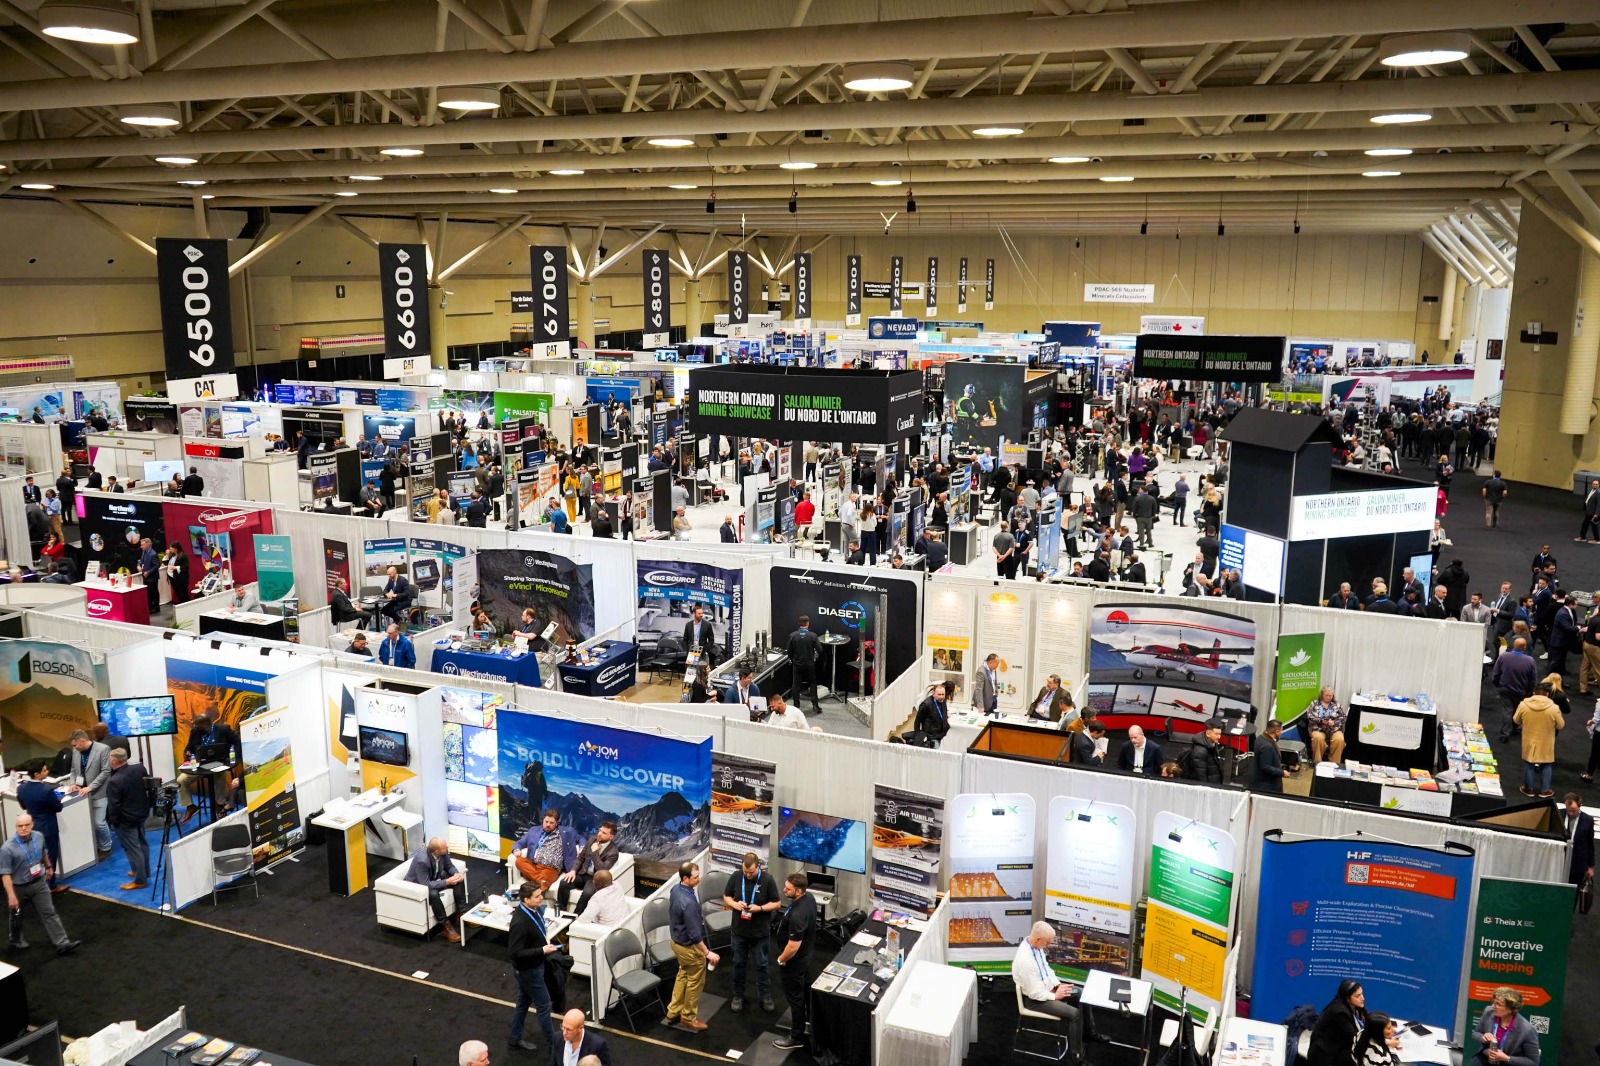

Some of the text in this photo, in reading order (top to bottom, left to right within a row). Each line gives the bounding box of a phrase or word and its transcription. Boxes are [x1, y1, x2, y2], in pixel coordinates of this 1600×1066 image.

[651, 266, 662, 328] 6800
[734, 266, 742, 320] 6900
[798, 267, 806, 314] 7000
[542, 266, 558, 336] 6700
[395, 266, 416, 350] 6600
[183, 266, 216, 367] 6500
[546, 346, 557, 356] CAT
[1144, 349, 1199, 360] NORTHERN ONTARIO
[1206, 352, 1247, 361] SALON MINIER
[404, 360, 414, 370] CAT
[1143, 359, 1196, 368] MINING SHOWCASE
[1205, 361, 1272, 371] DU NORD DE L'ONTARIO
[194, 380, 214, 398] CAT
[698, 389, 774, 407] NORTHERN ONTARIO
[784, 395, 842, 410] SALON MINIER
[698, 403, 772, 420] MINING SHOWCASE
[784, 408, 876, 425] DU NORD DE L'ONTARIO
[1305, 496, 1360, 509] NORTHERN ONTARIO
[1366, 493, 1405, 505] SALON MINIER
[1305, 507, 1357, 520] MINING SHOWCASE
[1366, 506, 1374, 516] DU
[1375, 505, 1390, 515] NORD
[1391, 504, 1398, 514] DE
[536, 584, 568, 598] Microreactor
[819, 606, 861, 619] DIASET
[33, 660, 75, 676] ROSOR
[460, 668, 506, 683] Westinghouse
[40, 712, 74, 723] DISCOVER
[1384, 723, 1419, 732] GEOLOGICAL
[579, 740, 618, 756] AXIOM
[579, 749, 618, 761] GROUP
[517, 747, 684, 791] BOLDLY DISCOVER
[1409, 799, 1447, 808] GEOLOGICAL
[1397, 870, 1425, 878] Development
[1094, 899, 1120, 908] CUSTOMERS
[1393, 905, 1434, 918] Characterization
[1155, 916, 1176, 927] RESULTS
[1495, 917, 1516, 926] Theia
[1481, 936, 1543, 952] Innovative
[1480, 948, 1525, 961] Mineral
[1478, 959, 1534, 975] Mapping
